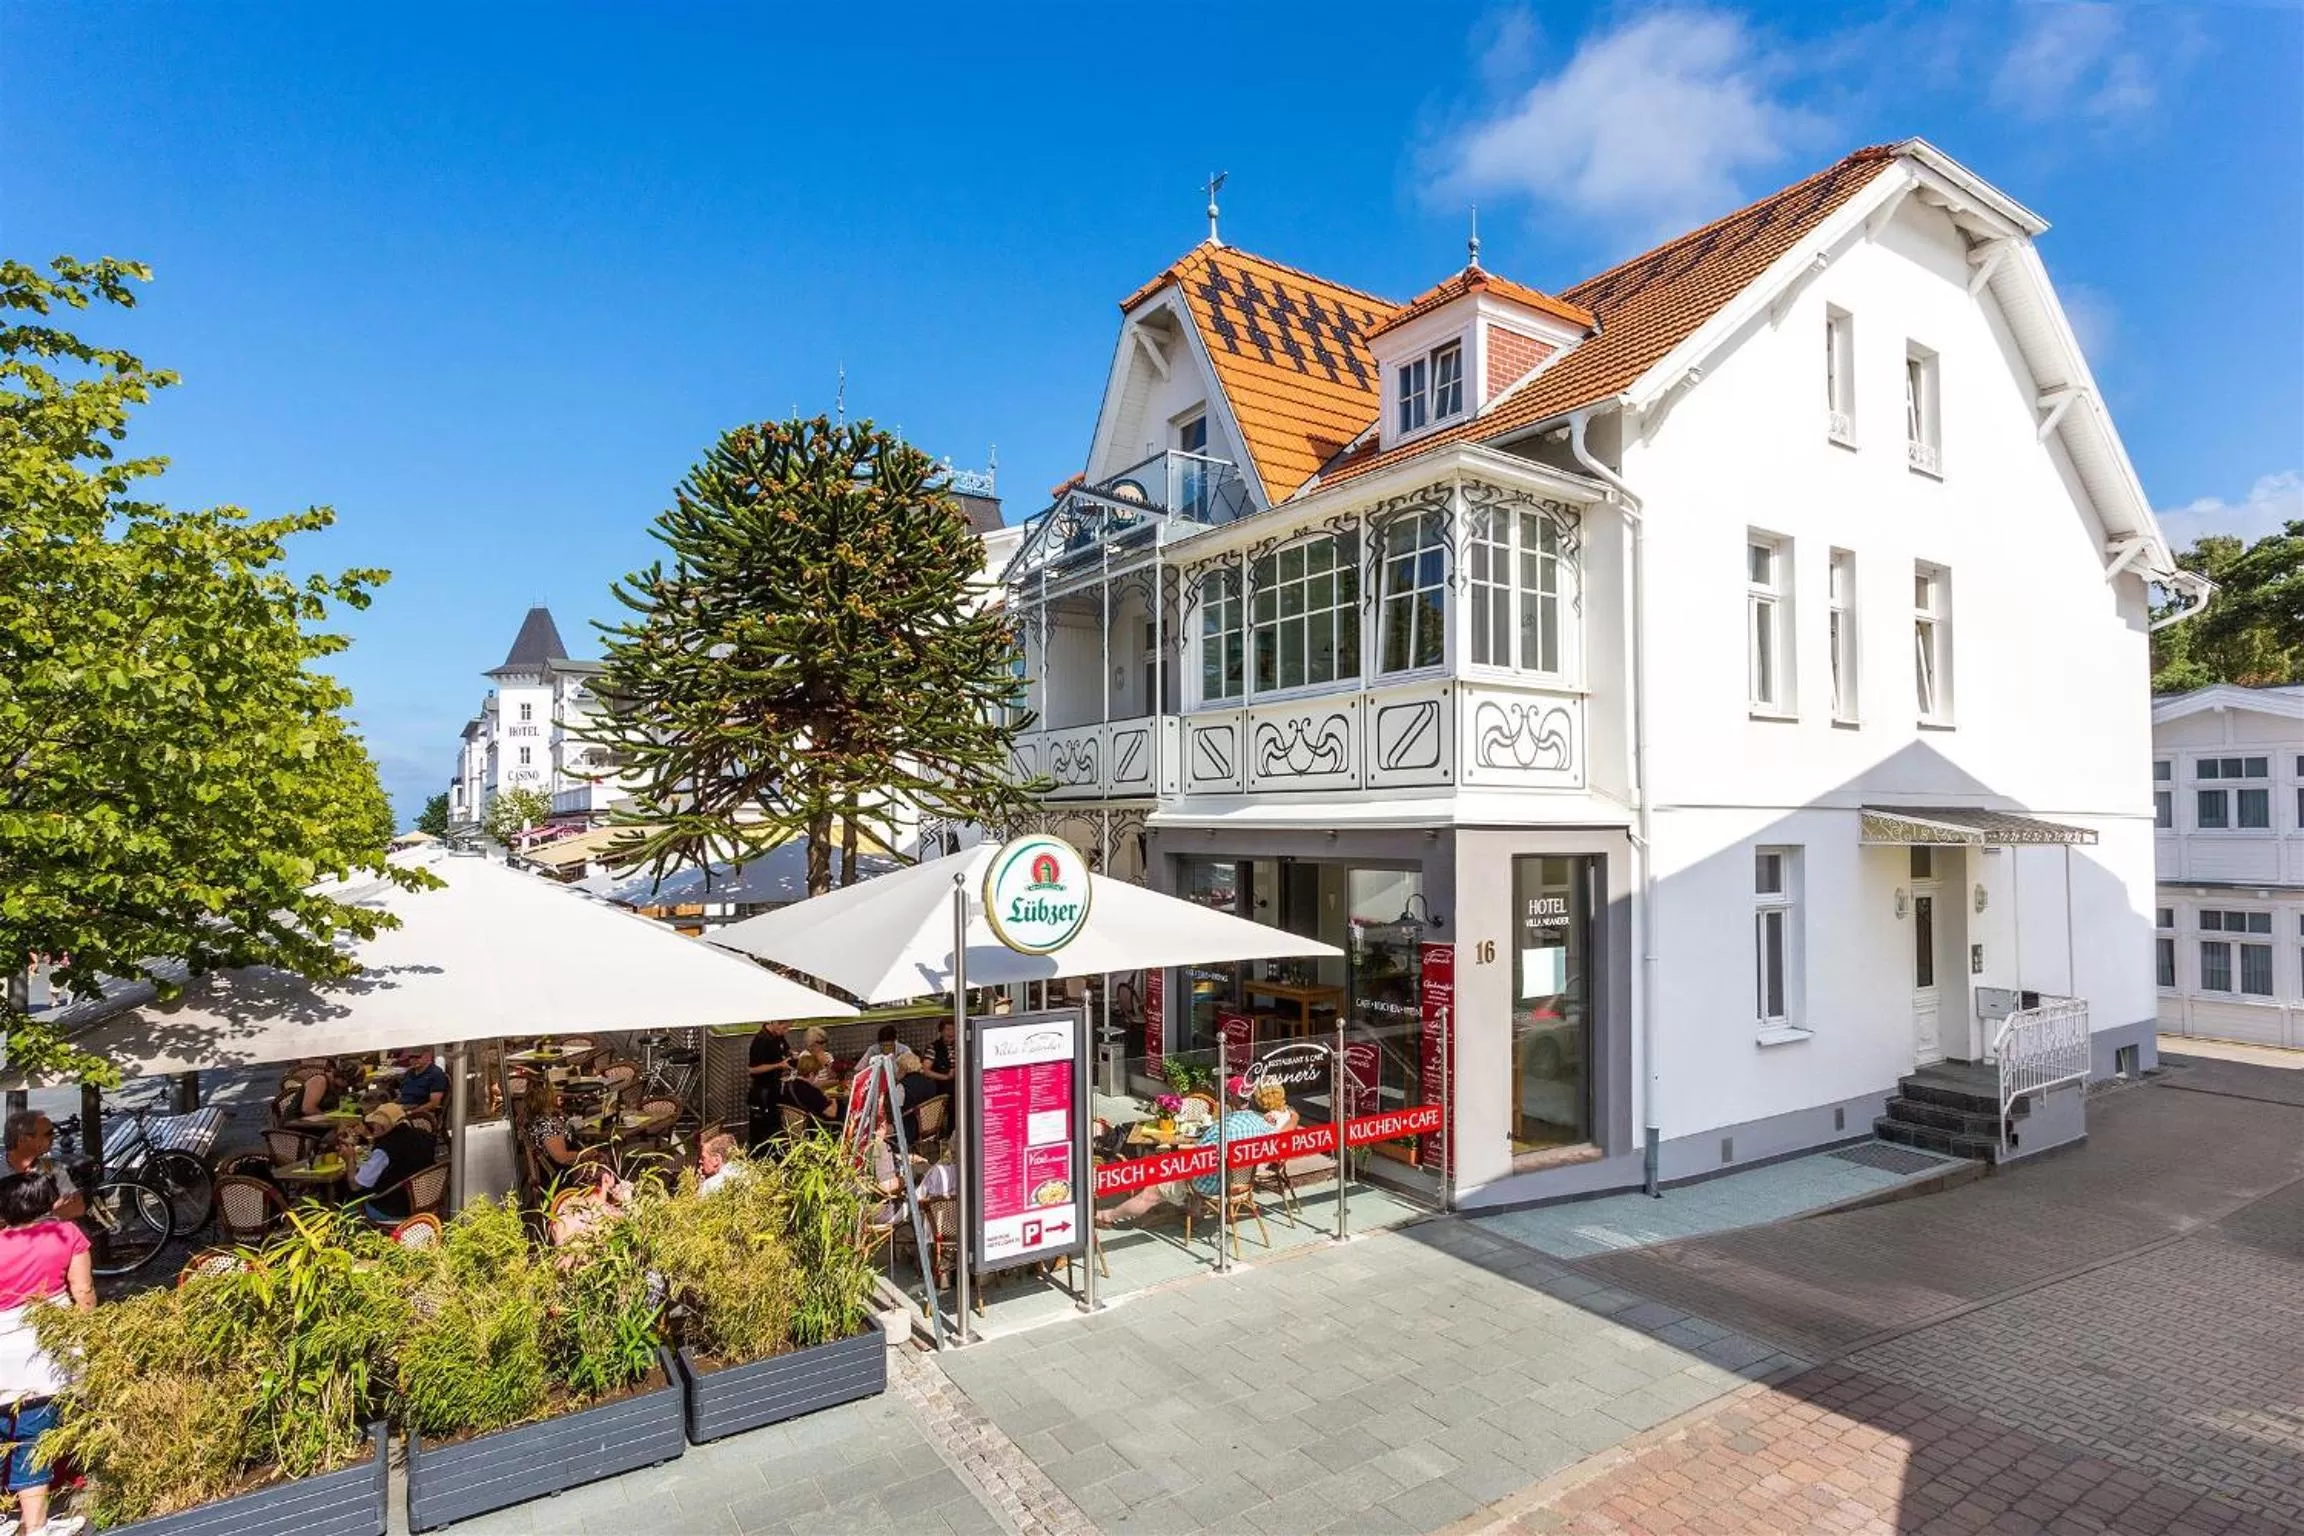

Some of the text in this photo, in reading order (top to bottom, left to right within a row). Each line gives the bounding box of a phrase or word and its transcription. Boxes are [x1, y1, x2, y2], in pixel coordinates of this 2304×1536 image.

[508, 726, 540, 737] HOTEL
[507, 770, 540, 782] CASINO
[1006, 897, 1077, 925] Lübzer
[1528, 898, 1567, 915] HOTEL
[1475, 940, 1496, 965] 16
[1349, 1109, 1440, 1140] KUCHEN CAFE
[1232, 1129, 1334, 1163] STEAK PASTA
[1097, 1163, 1145, 1189] FISCH
[1158, 1149, 1218, 1178] SALATE
[1025, 1223, 1040, 1244] P
